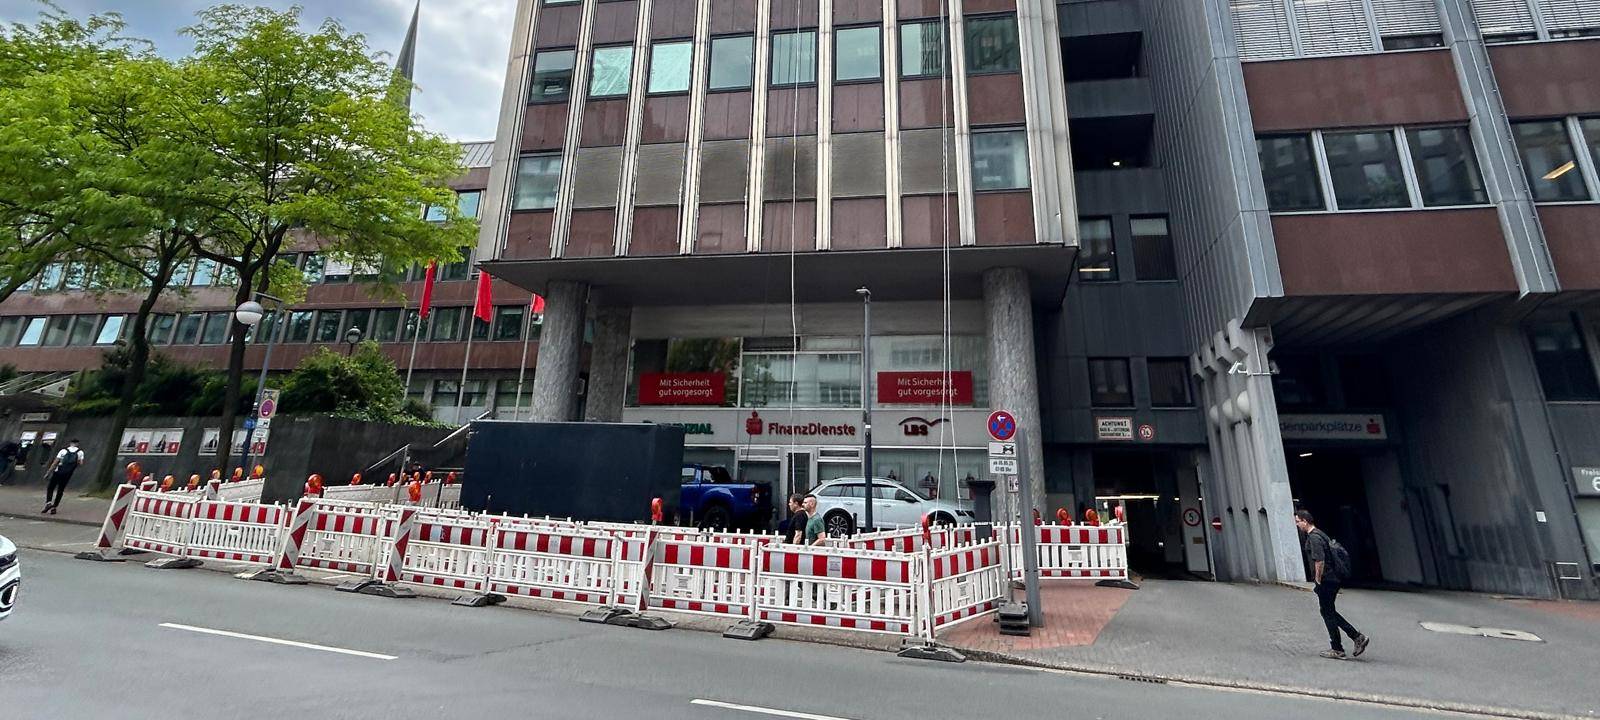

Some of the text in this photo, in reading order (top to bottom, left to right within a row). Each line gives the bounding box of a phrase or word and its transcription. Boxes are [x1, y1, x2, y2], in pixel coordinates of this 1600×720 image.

[660, 378, 711, 387] Mit Sicherheit
[897, 378, 911, 386] Mit
[659, 388, 713, 398] gut vorgesorgt
[897, 388, 911, 398] gut
[768, 422, 856, 436] FinanzDienste
[904, 424, 928, 436] LBS
[1279, 420, 1362, 434] denparkplätze
